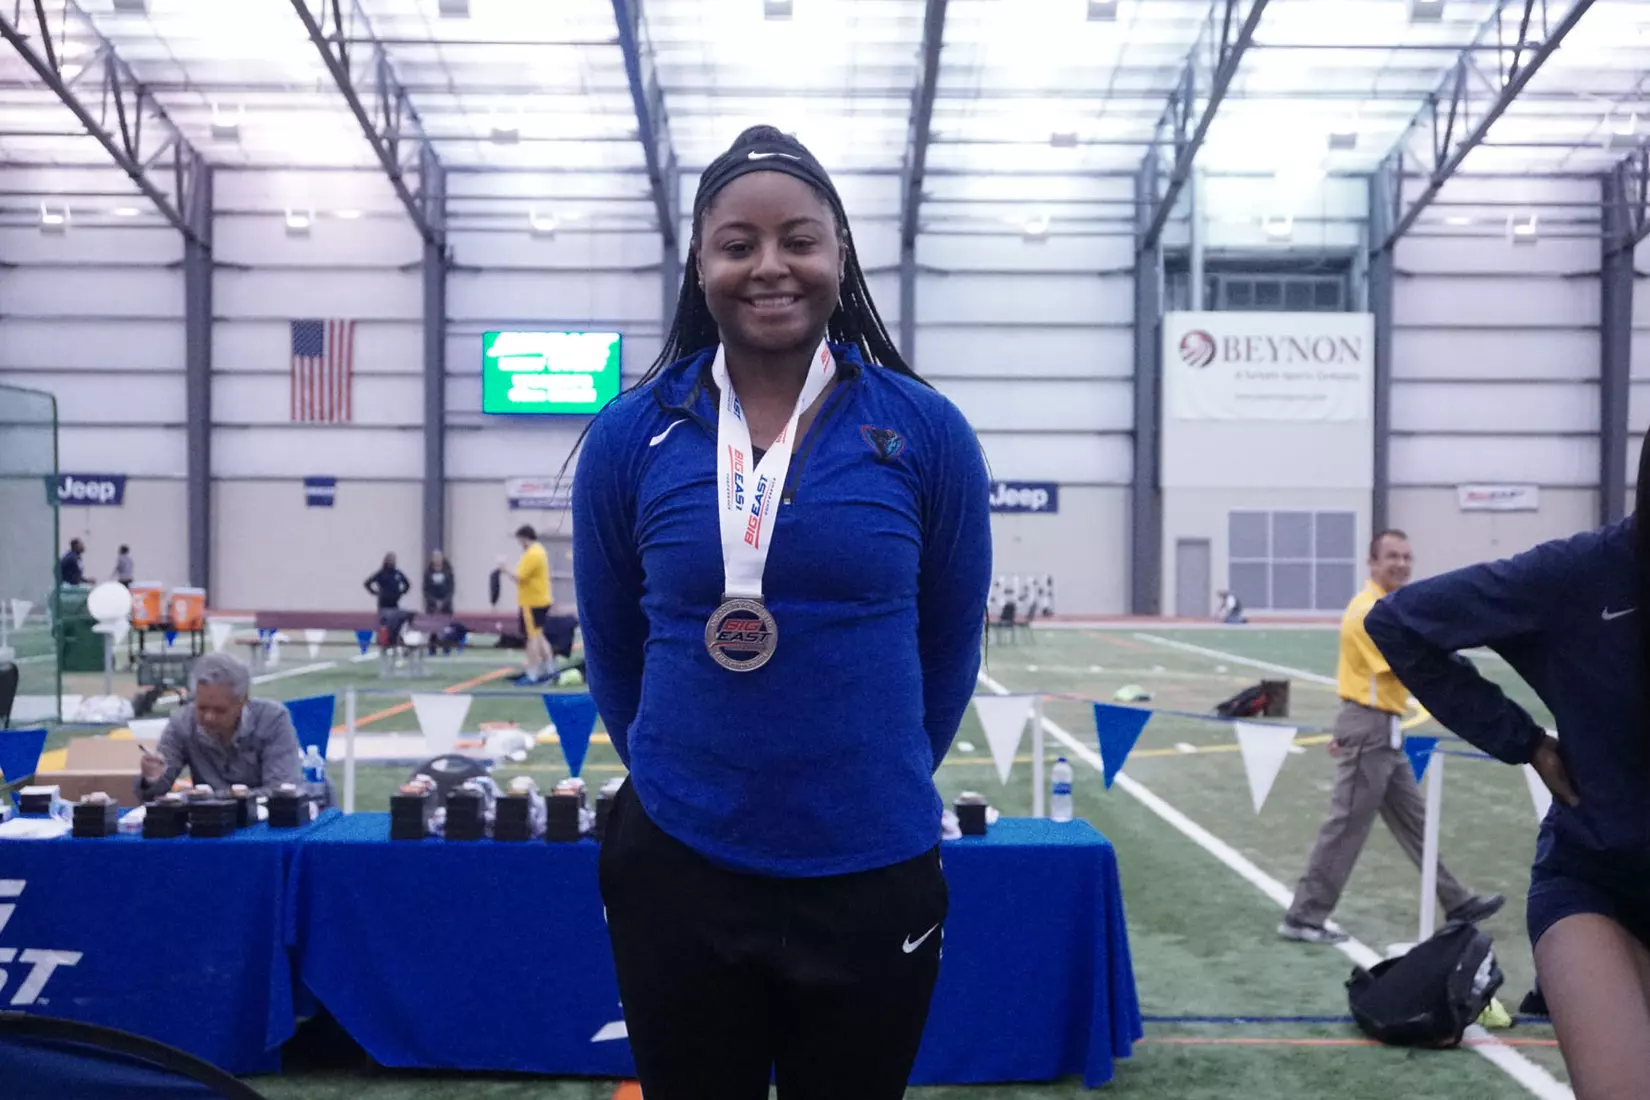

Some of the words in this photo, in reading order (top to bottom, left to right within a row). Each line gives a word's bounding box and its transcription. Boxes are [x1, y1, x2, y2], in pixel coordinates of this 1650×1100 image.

[1222, 335, 1362, 363] BEYNON
[57, 476, 116, 502] Jeep
[989, 483, 1048, 511] Jeep
[715, 631, 773, 642] EAST
[723, 619, 762, 632] BIG
